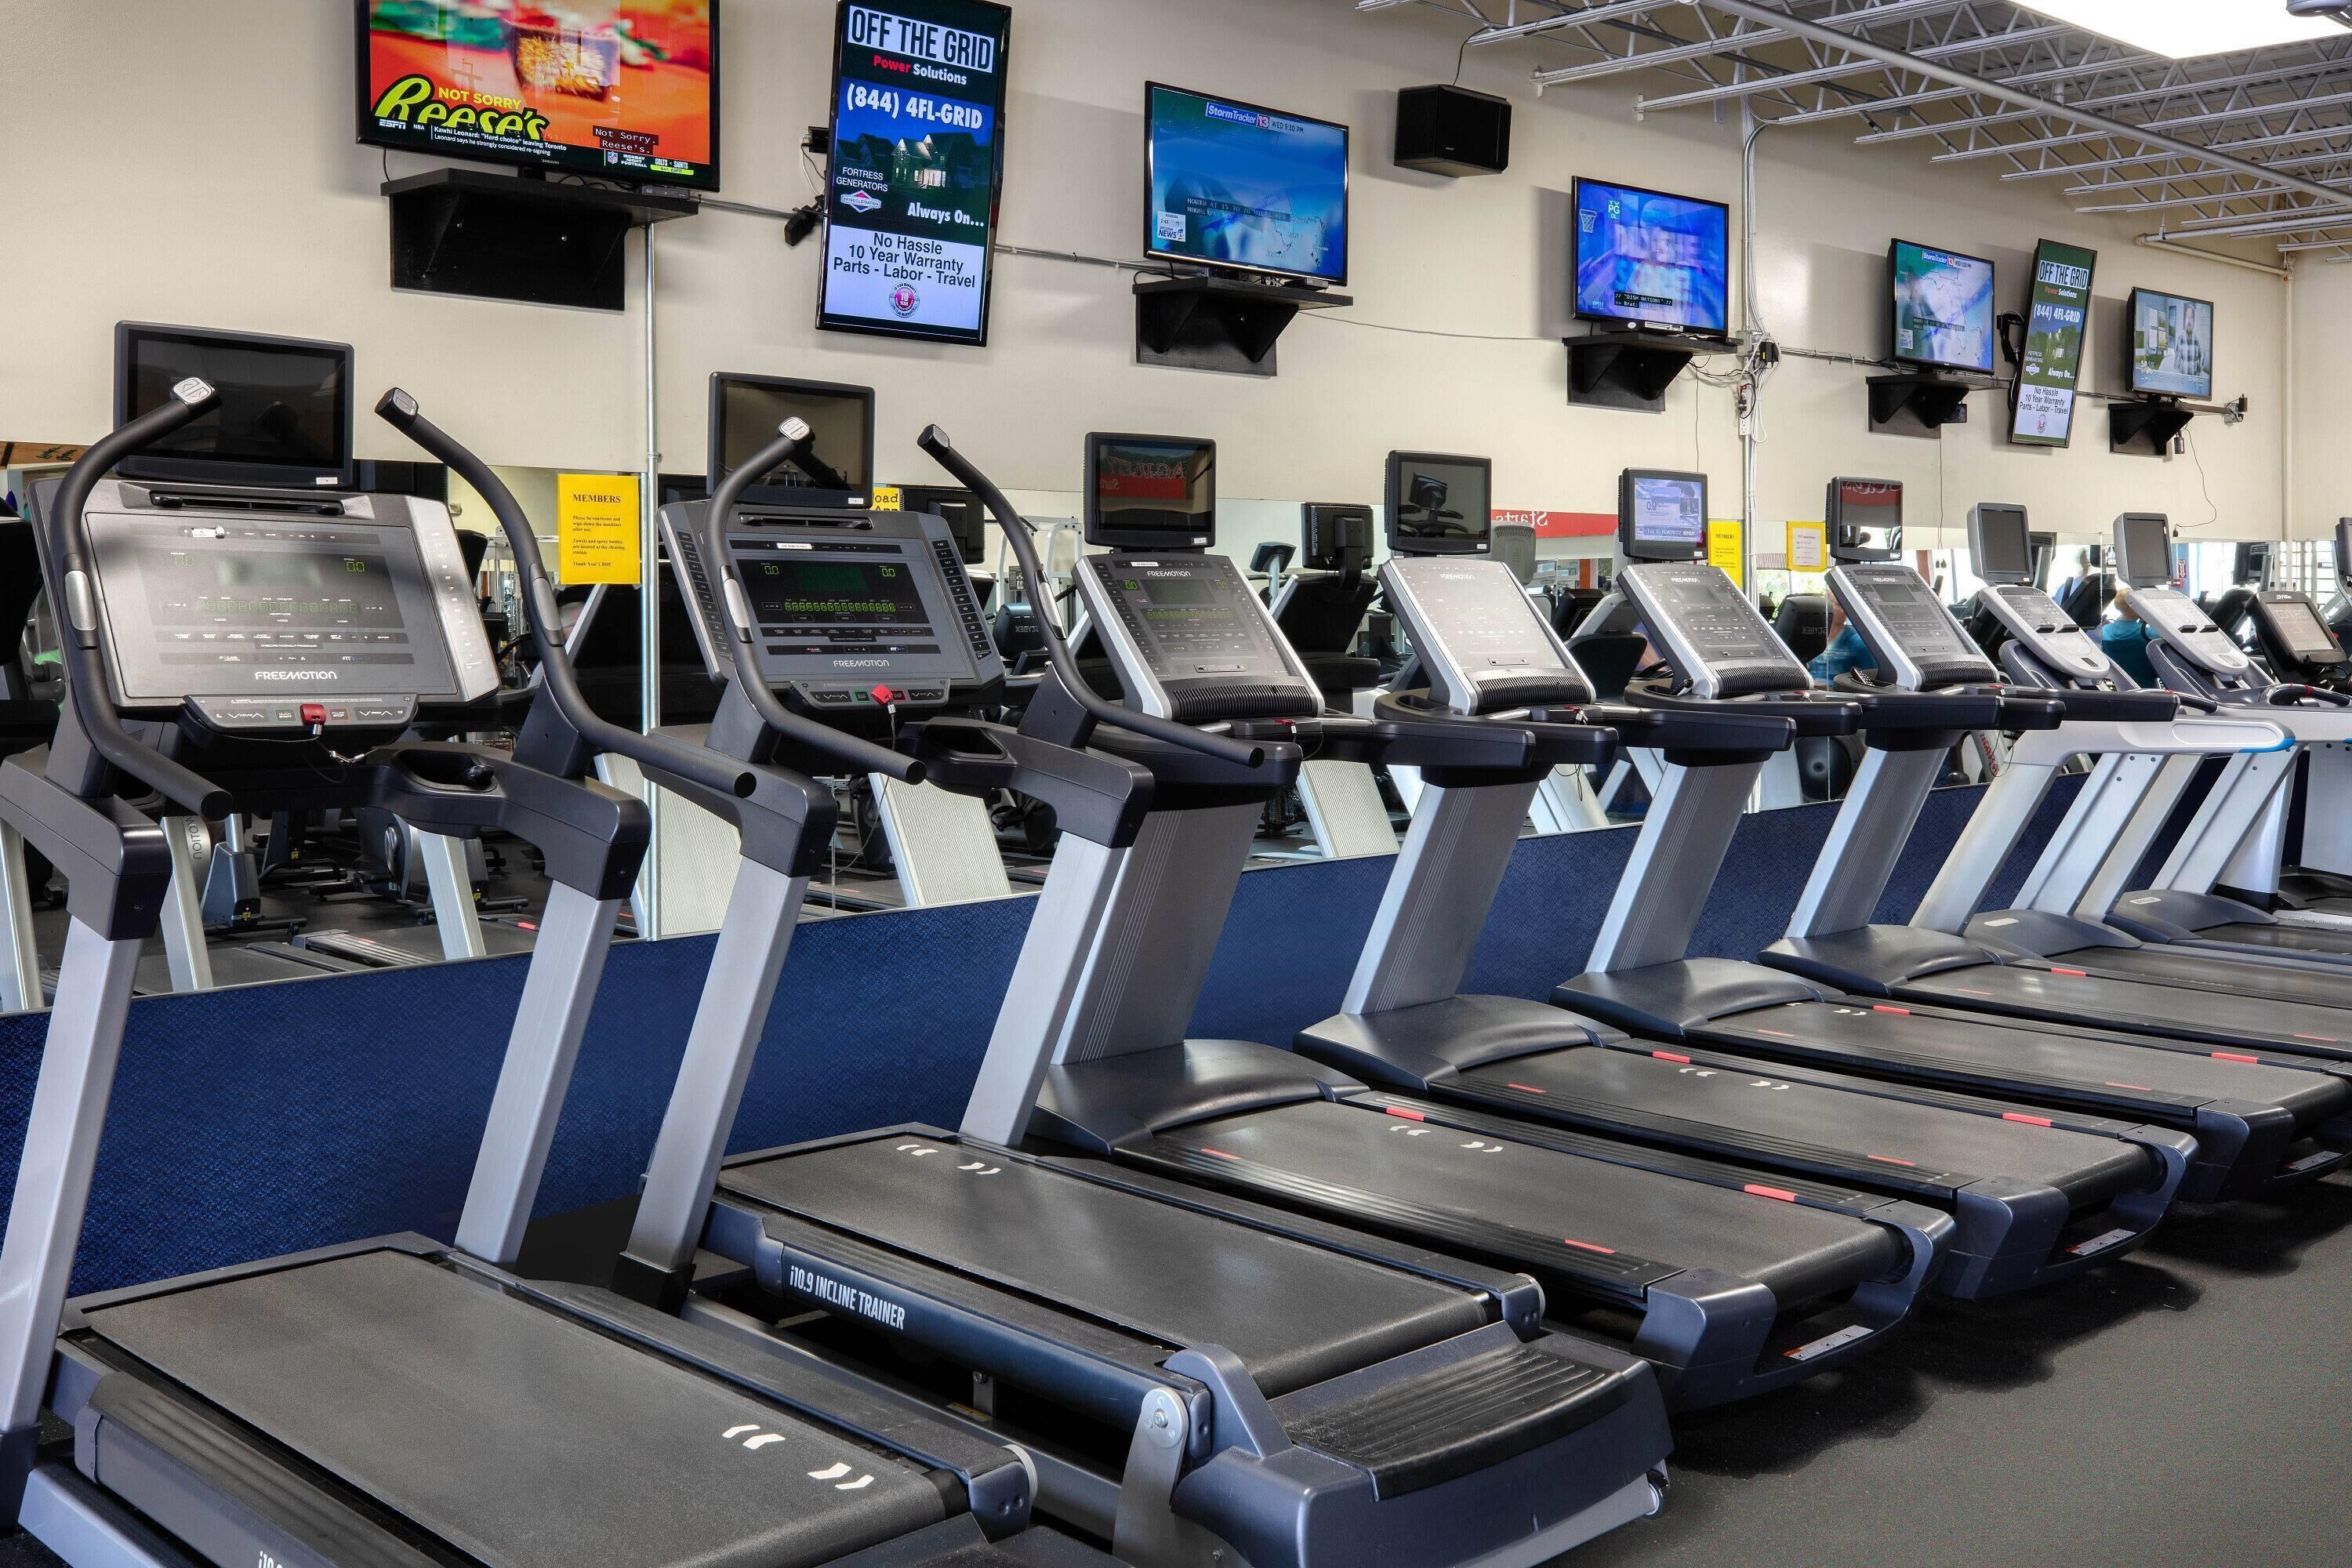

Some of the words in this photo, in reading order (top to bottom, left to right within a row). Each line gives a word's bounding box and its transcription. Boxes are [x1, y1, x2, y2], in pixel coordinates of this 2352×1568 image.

[851, 9, 892, 48] OFF
[898, 19, 938, 59] THE
[943, 30, 991, 70] GRID
[873, 54, 912, 73] Power
[913, 64, 967, 85] Solutions
[438, 87, 469, 102] NOT
[474, 93, 522, 111] SORRY
[847, 82, 899, 119] (844)
[906, 96, 982, 129] 4FL-GRID
[379, 118, 406, 129] ESPN
[1208, 105, 1257, 125] StormTracker
[1258, 115, 1269, 127] 13
[1272, 120, 1283, 129] WED
[453, 129, 481, 139] Leonard:
[499, 135, 522, 144] choice"
[523, 139, 543, 149] leaving
[544, 142, 567, 151] Toronto
[595, 128, 613, 138] Not
[620, 132, 656, 144] Sorry.
[477, 140, 497, 150] strongly
[498, 143, 526, 152] considered
[526, 147, 551, 156] re-signing
[601, 140, 651, 154] Reese's.
[655, 158, 668, 166] COLTS
[674, 161, 688, 169] SAINTS
[842, 166, 884, 180] FORTRESS
[836, 176, 888, 192] GENERATORS
[907, 202, 951, 224] Always
[954, 209, 984, 227] On...
[1608, 205, 1620, 214] PG
[1159, 229, 1177, 238] NEWS
[873, 232, 892, 248] No
[897, 235, 942, 255] Hassle
[848, 245, 865, 259] 10
[869, 246, 900, 263] Year
[904, 252, 964, 275] Warranty
[833, 256, 870, 274] Parts
[884, 263, 923, 281] Labor
[937, 270, 975, 288] Travel
[2039, 261, 2053, 281] OFF
[2055, 264, 2070, 285] THE
[2071, 267, 2088, 289] GRID
[2058, 289, 2078, 299] Solutions
[2034, 303, 2053, 321] (844)
[2054, 307, 2081, 323] 4FL-GRID
[2048, 367, 2063, 379] Always
[2034, 386, 2042, 394] No
[2042, 387, 2059, 397] Hassle
[2019, 401, 2032, 410] Parts
[2036, 404, 2050, 412] Labor
[2054, 405, 2068, 415] Travel
[2032, 395, 2042, 404] Year
[2044, 396, 2065, 407] Warranty
[572, 494, 621, 503] MEMBERS
[874, 493, 898, 503] oad
[254, 671, 338, 681] FREEMOTION
[789, 1265, 814, 1293] i10.9
[815, 1275, 857, 1311] INCLINE
[858, 1291, 906, 1330] TRAINER
